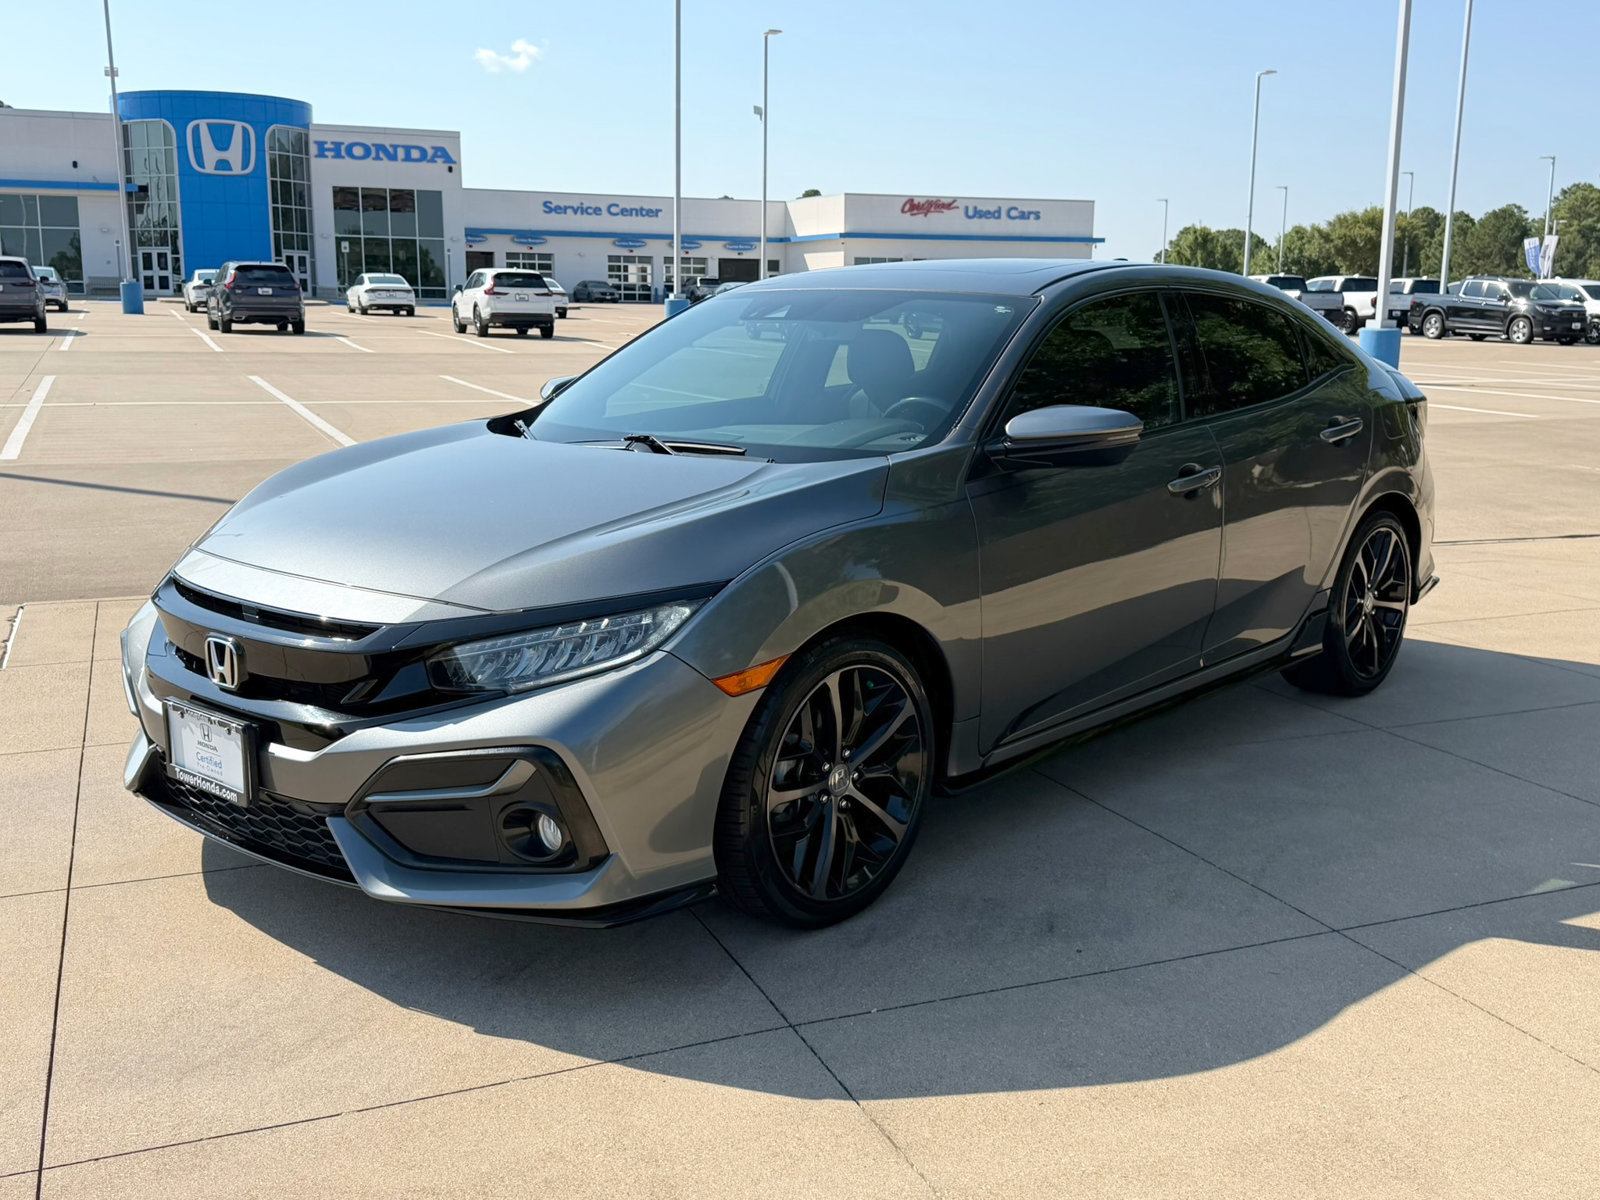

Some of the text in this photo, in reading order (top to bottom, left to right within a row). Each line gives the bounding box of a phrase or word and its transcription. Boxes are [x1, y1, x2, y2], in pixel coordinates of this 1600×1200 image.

[313, 140, 457, 165] HONDA
[542, 200, 663, 218] Service Center
[964, 205, 1002, 220] Used
[1006, 206, 1042, 220] Cars
[175, 767, 238, 803] TowerHonda.com
